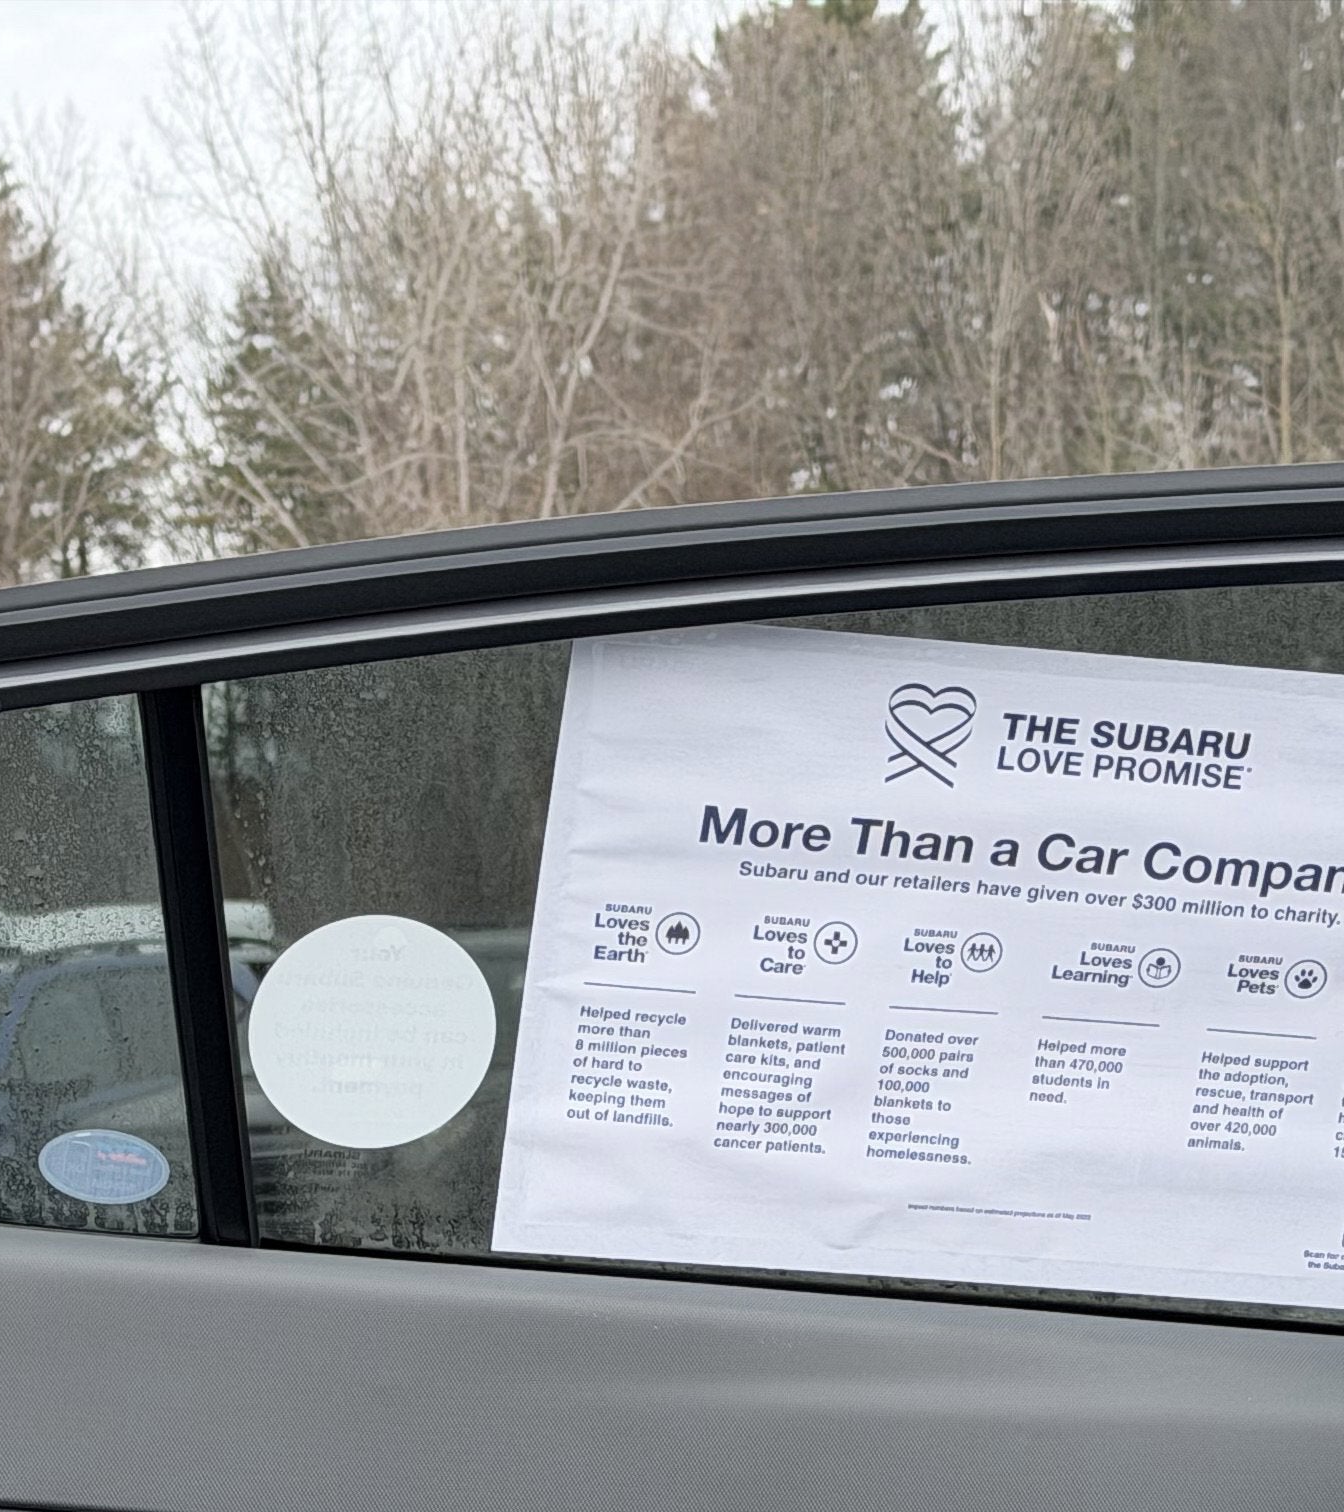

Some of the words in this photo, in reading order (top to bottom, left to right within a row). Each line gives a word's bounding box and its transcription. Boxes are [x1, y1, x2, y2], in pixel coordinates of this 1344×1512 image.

[1002, 712, 1081, 746] THE
[1089, 720, 1252, 761] SUBARU
[996, 745, 1085, 777] LOVE
[698, 804, 832, 853] More
[850, 816, 974, 864] Than
[989, 838, 1020, 868] a
[1037, 832, 1130, 876] Car
[738, 860, 809, 881] Subaru
[813, 868, 851, 884] and
[855, 873, 890, 887] our
[892, 874, 971, 894] retailers
[976, 879, 1022, 898] have
[1026, 884, 1080, 904] given
[1084, 892, 1128, 908] over
[1131, 892, 1177, 913] $300
[1181, 898, 1245, 918] million
[1250, 903, 1269, 920] to
[1273, 905, 1341, 929] charity.
[604, 903, 653, 916] SUBARU
[594, 912, 651, 932] Loves
[763, 915, 811, 928] SUBARU
[617, 930, 649, 948] the
[752, 924, 809, 945] Loves
[913, 928, 959, 939] SUBARU
[787, 944, 806, 961] to
[903, 936, 956, 955] Loves
[1090, 941, 1137, 954] SUBARU
[935, 955, 953, 970] to
[1079, 950, 1133, 970] Loves
[1237, 954, 1284, 966] SUBARU
[1226, 962, 1281, 981] Loves
[579, 1005, 632, 1023] Helped
[634, 1012, 687, 1027] recycle
[577, 1024, 615, 1037] more
[618, 1025, 651, 1040] than
[730, 1017, 799, 1035] Delivered
[802, 1025, 842, 1038] warm
[884, 1028, 945, 1045] Donated
[947, 1035, 980, 1046] over
[574, 1038, 584, 1051] 8
[587, 1040, 637, 1055] million
[639, 1043, 688, 1059] pieces
[727, 1033, 793, 1053] blankets,
[795, 1040, 846, 1056] patient
[1037, 1038, 1088, 1056] Helped
[1089, 1045, 1127, 1057] more
[572, 1055, 589, 1068] of
[591, 1055, 625, 1071] hard
[627, 1059, 643, 1072] to
[725, 1052, 757, 1065] care
[760, 1052, 790, 1070] kits,
[793, 1057, 822, 1071] and
[881, 1045, 936, 1061] 500,000
[938, 1049, 974, 1064] pairs
[1201, 1050, 1252, 1068] Helped
[1253, 1057, 1310, 1073] support
[879, 1062, 895, 1075] of
[896, 1064, 939, 1078] socks
[941, 1066, 970, 1079] and
[1034, 1055, 1066, 1070] than
[1068, 1058, 1124, 1074] 470,000
[570, 1074, 623, 1089] recycle
[626, 1078, 673, 1095] waste,
[722, 1069, 813, 1090] encouraging
[877, 1078, 931, 1094] 100,000
[1031, 1073, 1093, 1089] students
[1096, 1076, 1110, 1090] in
[1198, 1067, 1221, 1081] the
[1223, 1070, 1289, 1089] adoption,
[568, 1088, 626, 1109] keeping
[630, 1094, 666, 1109] them
[720, 1086, 793, 1104] messages
[796, 1091, 813, 1104] of
[873, 1094, 934, 1111] blankets
[937, 1099, 952, 1112] to
[1029, 1091, 1067, 1104] need.
[1195, 1086, 1246, 1103] rescue,
[1249, 1088, 1315, 1106] transport
[566, 1107, 591, 1121] out
[594, 1108, 610, 1122] of
[612, 1109, 674, 1128] landfills.
[718, 1101, 755, 1119] hope
[758, 1104, 773, 1117] to
[775, 1108, 832, 1122] support
[871, 1111, 911, 1126] those
[1192, 1102, 1220, 1115] and
[1221, 1103, 1265, 1119] health
[1268, 1107, 1285, 1120] of
[715, 1119, 761, 1136] nearly
[762, 1121, 818, 1137] 300,000
[1189, 1120, 1222, 1133] over
[1223, 1120, 1277, 1137] 420,000
[713, 1137, 763, 1150] cancer
[764, 1139, 826, 1155] patients.
[868, 1130, 960, 1150] experiencing
[1187, 1136, 1245, 1152] animals.
[865, 1144, 972, 1165] homelessness.
